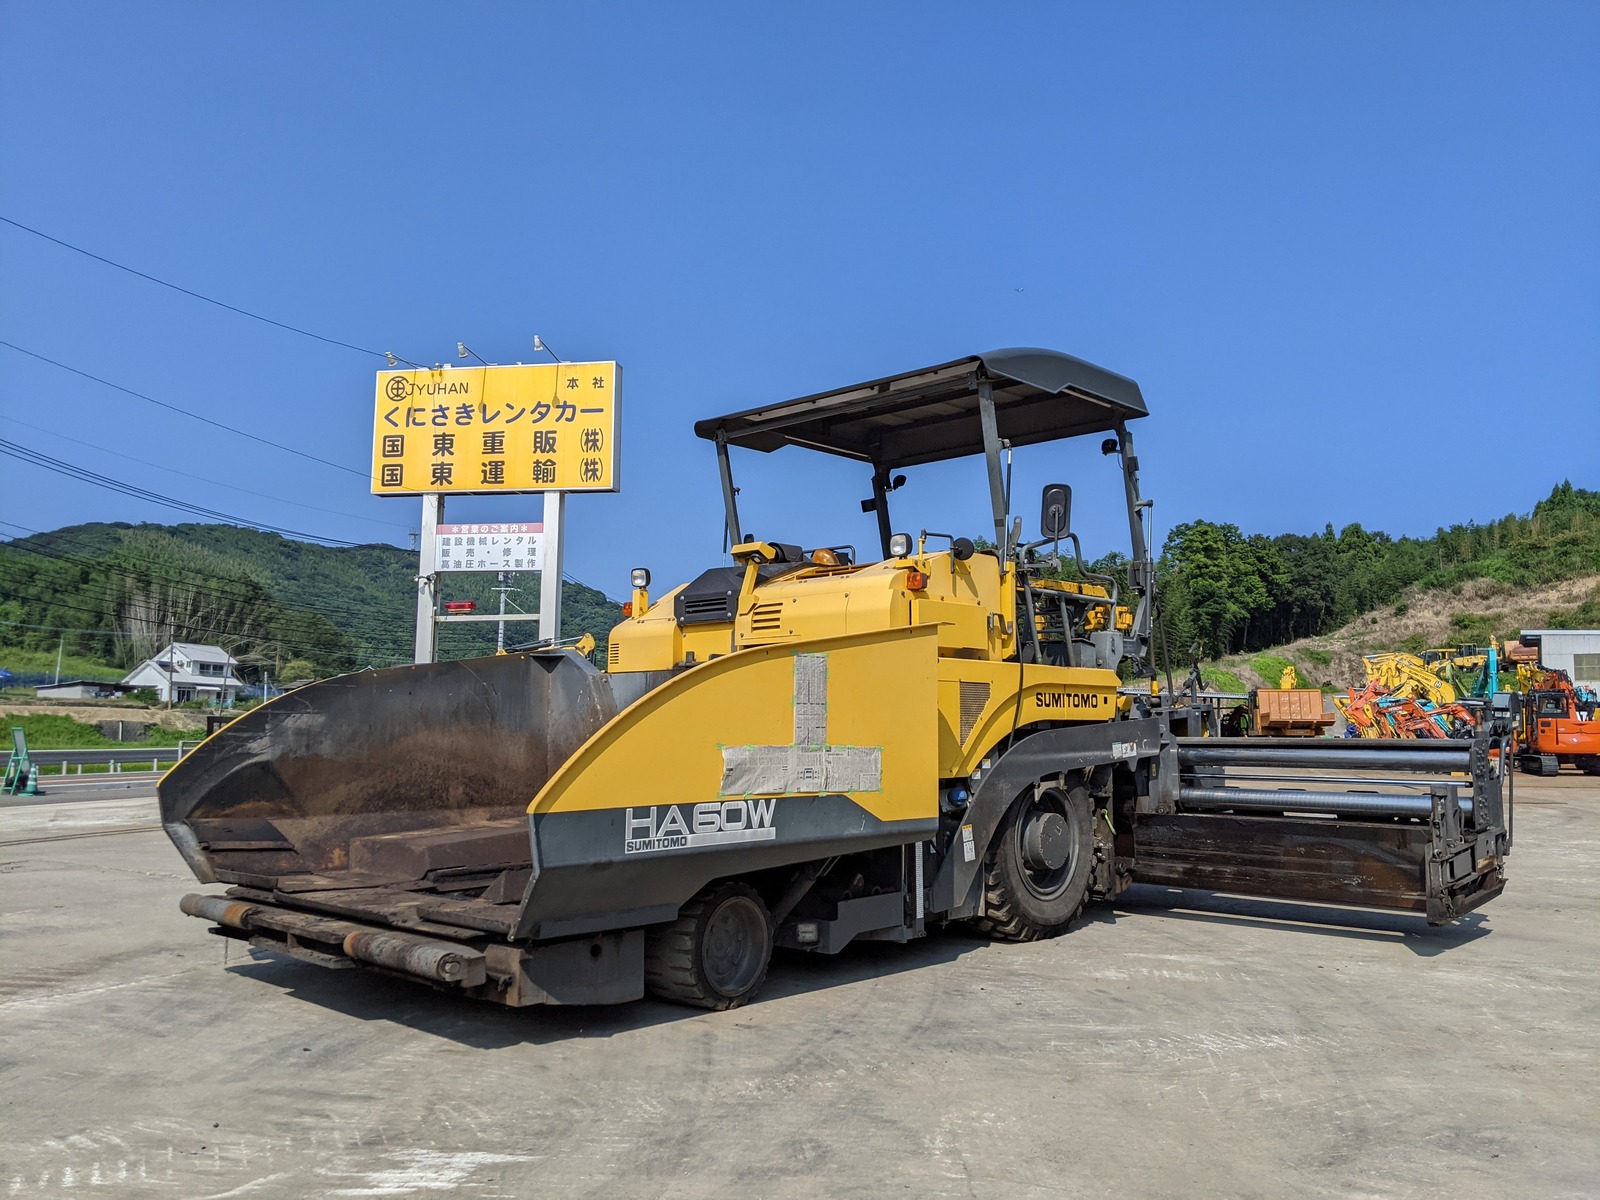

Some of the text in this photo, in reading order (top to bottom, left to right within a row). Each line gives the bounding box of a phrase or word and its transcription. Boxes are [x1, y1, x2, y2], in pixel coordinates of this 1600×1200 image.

[405, 382, 469, 396] JYUHAN
[566, 376, 605, 390] 本社
[384, 400, 605, 428] くにさきレンタカー
[441, 536, 537, 547] 建設機械レンタル
[441, 558, 536, 569] 高油圧ホース製作
[1035, 692, 1098, 708] SUMITOMO
[625, 798, 777, 840] HA60W
[626, 836, 688, 852] SUMITOMO
